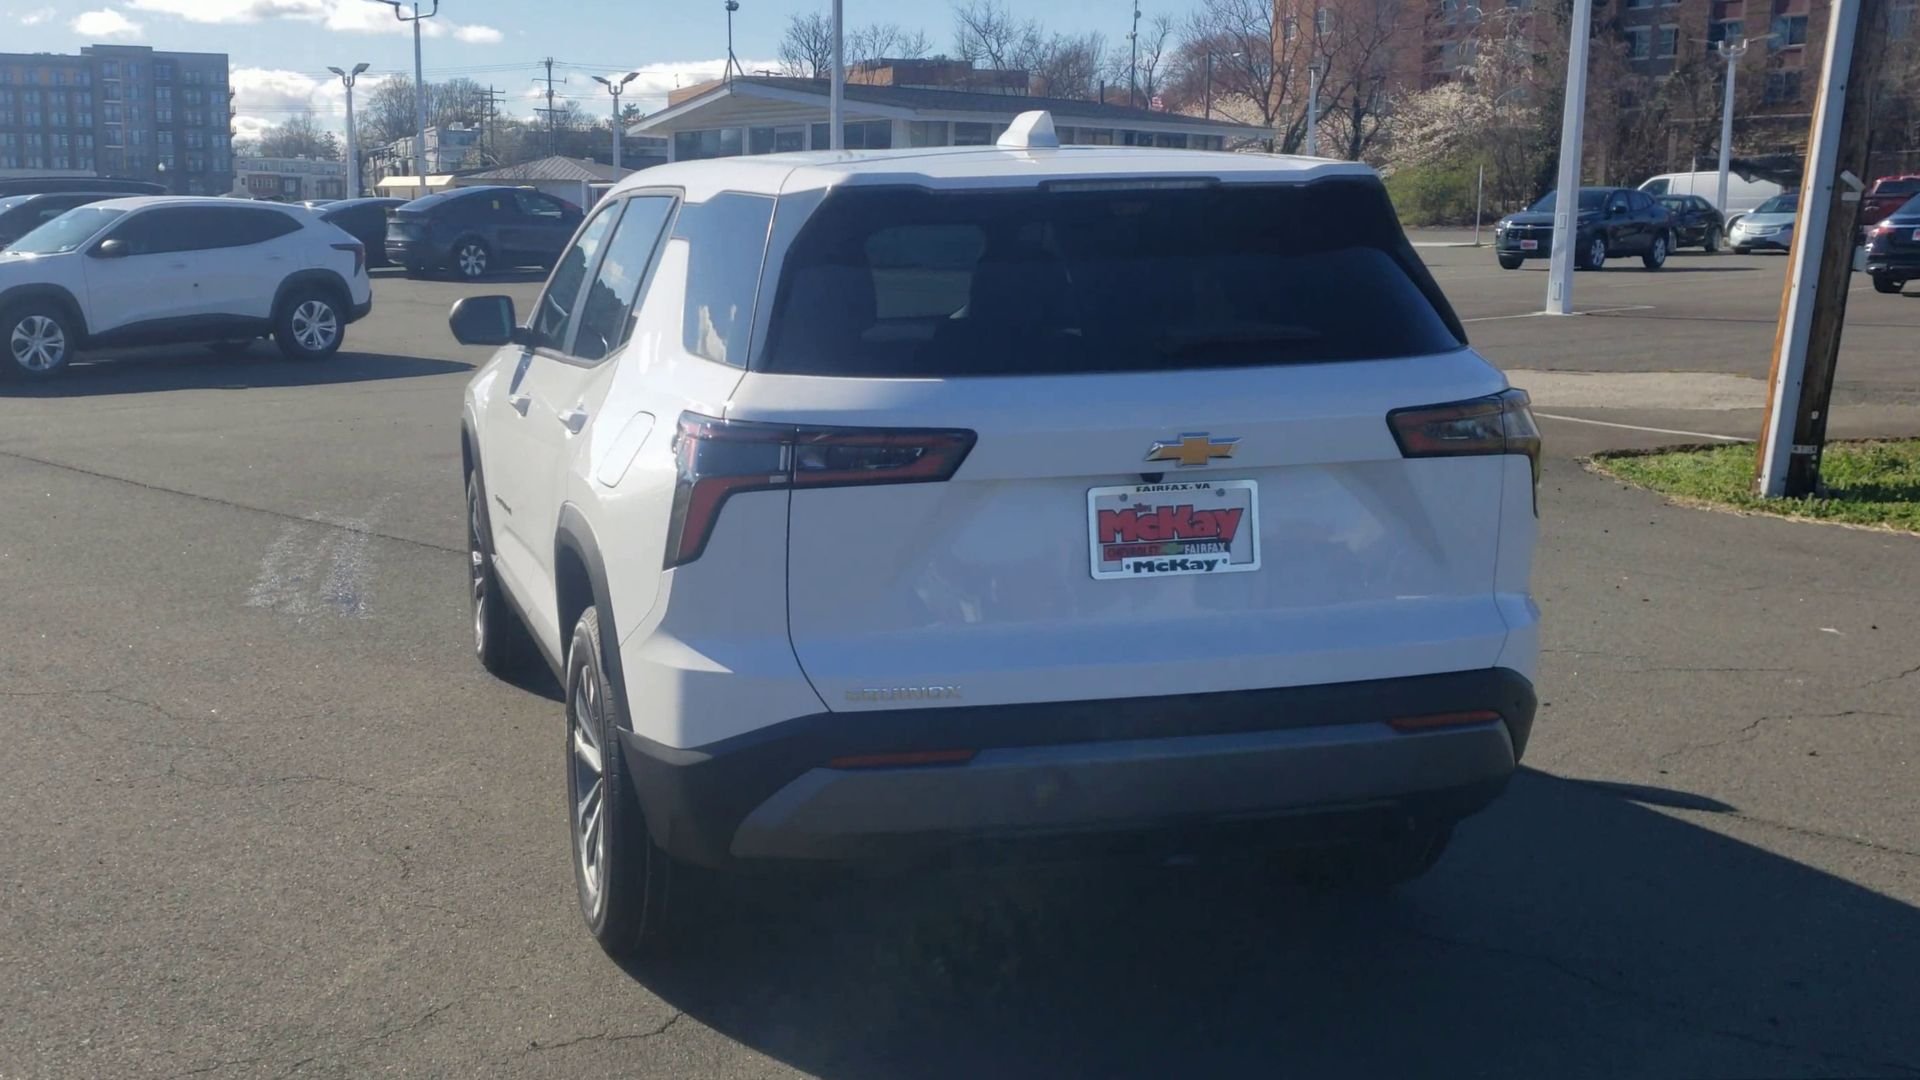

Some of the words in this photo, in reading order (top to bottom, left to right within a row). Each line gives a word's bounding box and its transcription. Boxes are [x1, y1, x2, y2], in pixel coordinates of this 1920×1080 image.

[1195, 482, 1211, 490] VA
[1097, 504, 1245, 544] McKay
[1184, 542, 1226, 555] FAIRFAX
[1132, 558, 1219, 573] McKay
